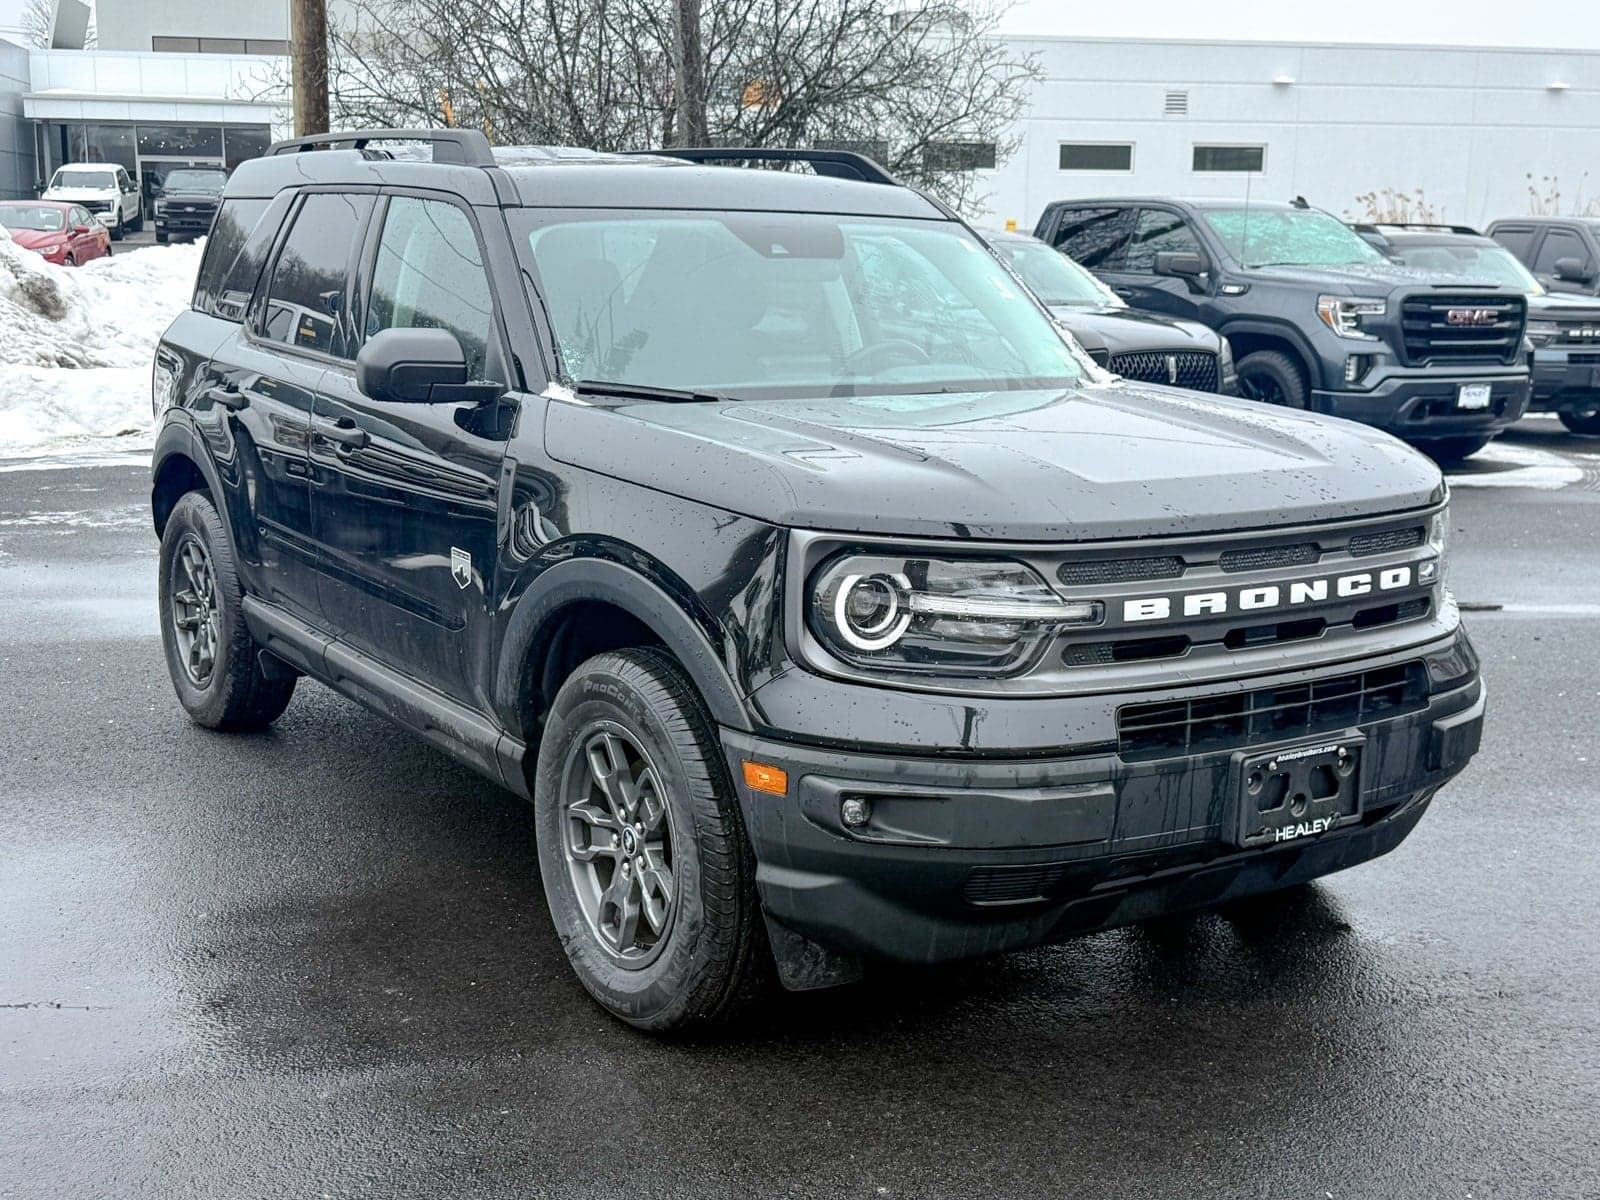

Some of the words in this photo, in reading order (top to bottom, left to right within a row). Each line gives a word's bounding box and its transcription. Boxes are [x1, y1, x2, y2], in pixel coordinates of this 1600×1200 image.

[1447, 310, 1498, 325] GMC
[1123, 566, 1411, 622] BRONCO
[1275, 816, 1332, 842] HEALEY
